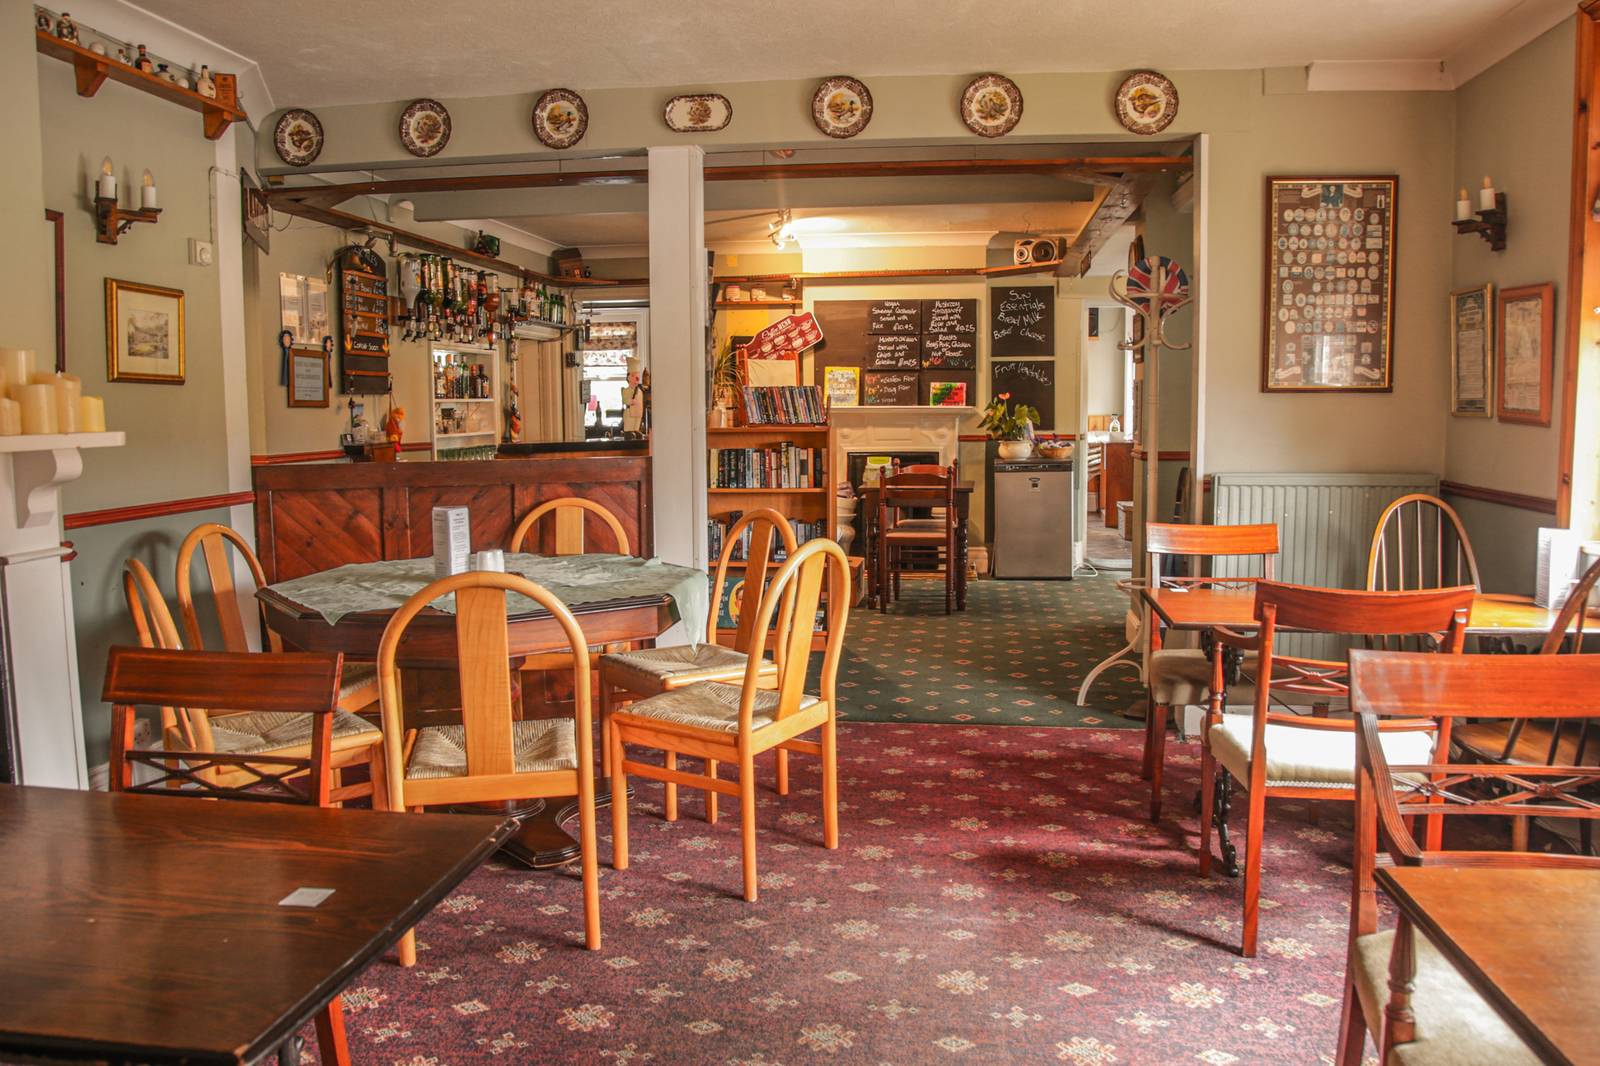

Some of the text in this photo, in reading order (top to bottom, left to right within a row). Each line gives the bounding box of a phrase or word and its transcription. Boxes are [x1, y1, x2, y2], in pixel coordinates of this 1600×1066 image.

[1000, 298, 1046, 312] Essentials
[997, 311, 1043, 326] Bread Milk
